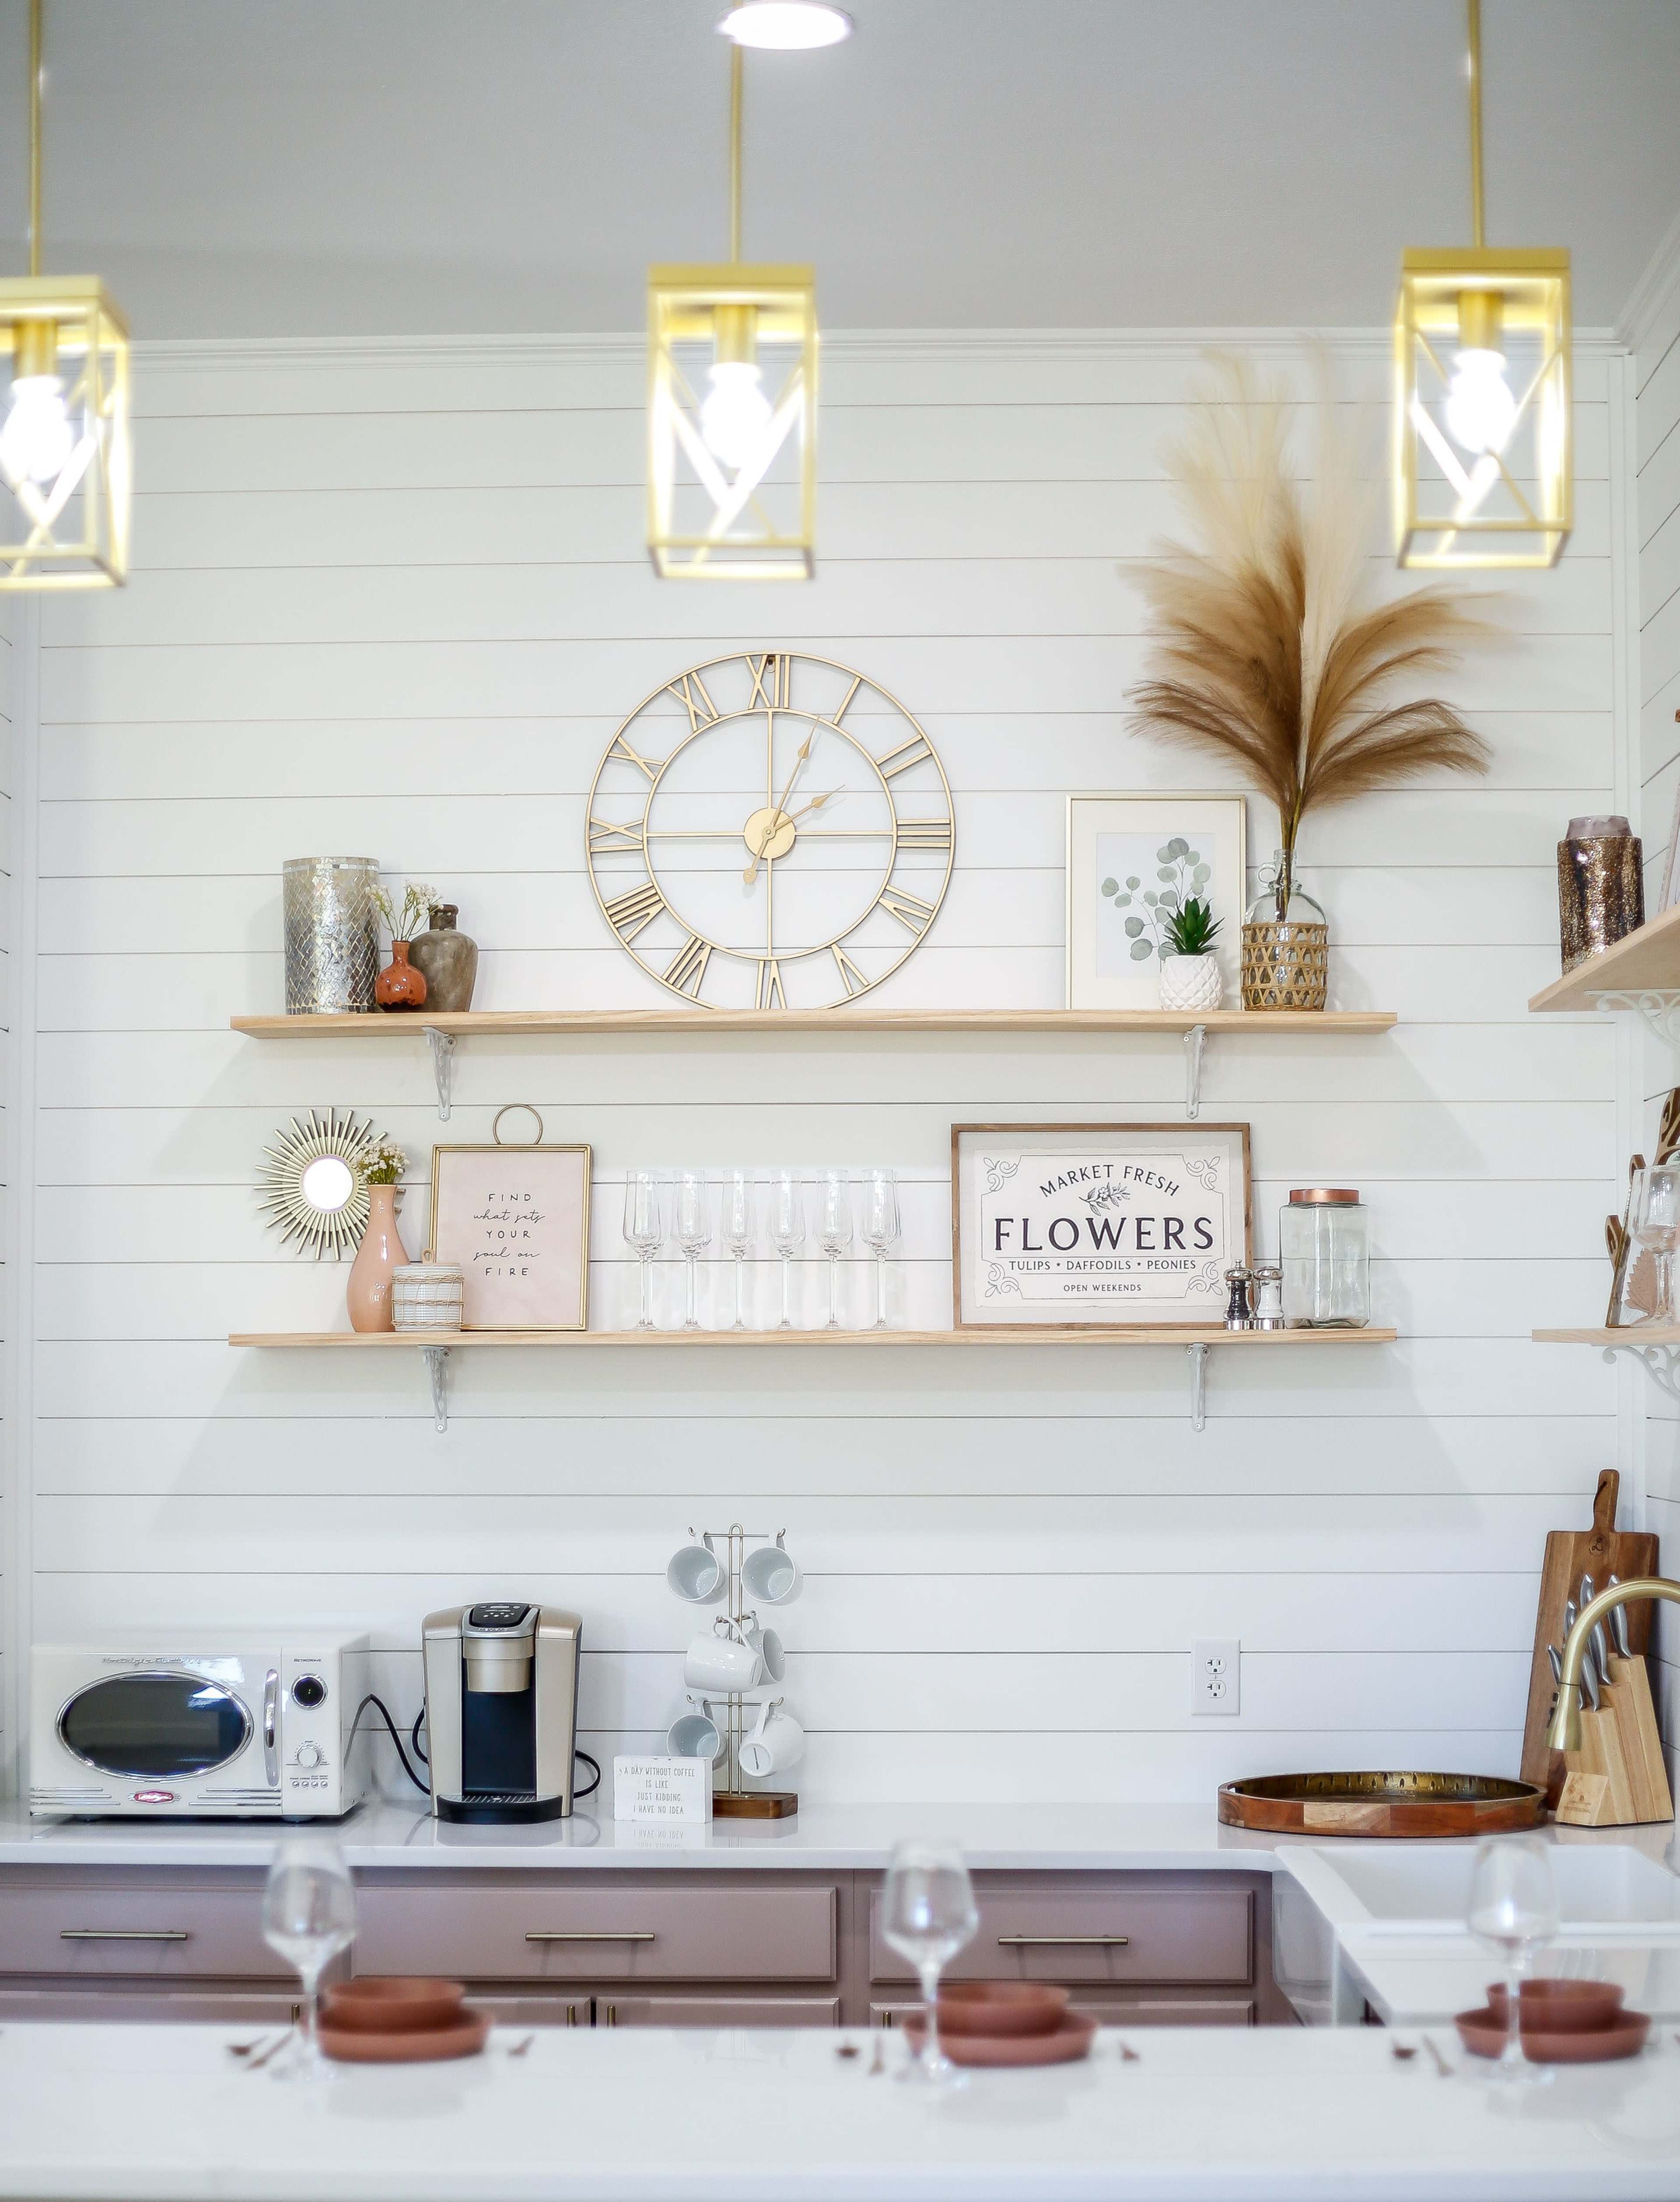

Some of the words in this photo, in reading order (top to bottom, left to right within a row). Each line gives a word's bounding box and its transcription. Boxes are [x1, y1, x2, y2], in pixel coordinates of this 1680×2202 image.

[1039, 1164, 1114, 1197] MARKET
[1123, 1166, 1180, 1197] FRESH
[488, 1193, 532, 1202] FIND
[473, 1208, 511, 1221] what
[514, 1209, 546, 1224] sets
[486, 1230, 531, 1239] YOUR
[994, 1217, 1214, 1251] FLOWERS
[473, 1246, 511, 1261] soul
[1008, 1260, 1050, 1271] TULIPS
[1067, 1260, 1131, 1270] DAFFODILS
[1147, 1260, 1196, 1270] PEONIES
[485, 1267, 529, 1276] FIRE
[624, 1766, 629, 1775] A
[631, 1766, 644, 1775] DAY
[645, 1767, 671, 1776] WITHOUT
[674, 1768, 695, 1777] COFFEE
[646, 1779, 652, 1788] IS
[655, 1780, 668, 1789] LIKE
[637, 1792, 652, 1801] JUST
[655, 1792, 681, 1802] KIDDING
[639, 1805, 654, 1813] HAVE
[669, 1806, 684, 1814] IDEA
